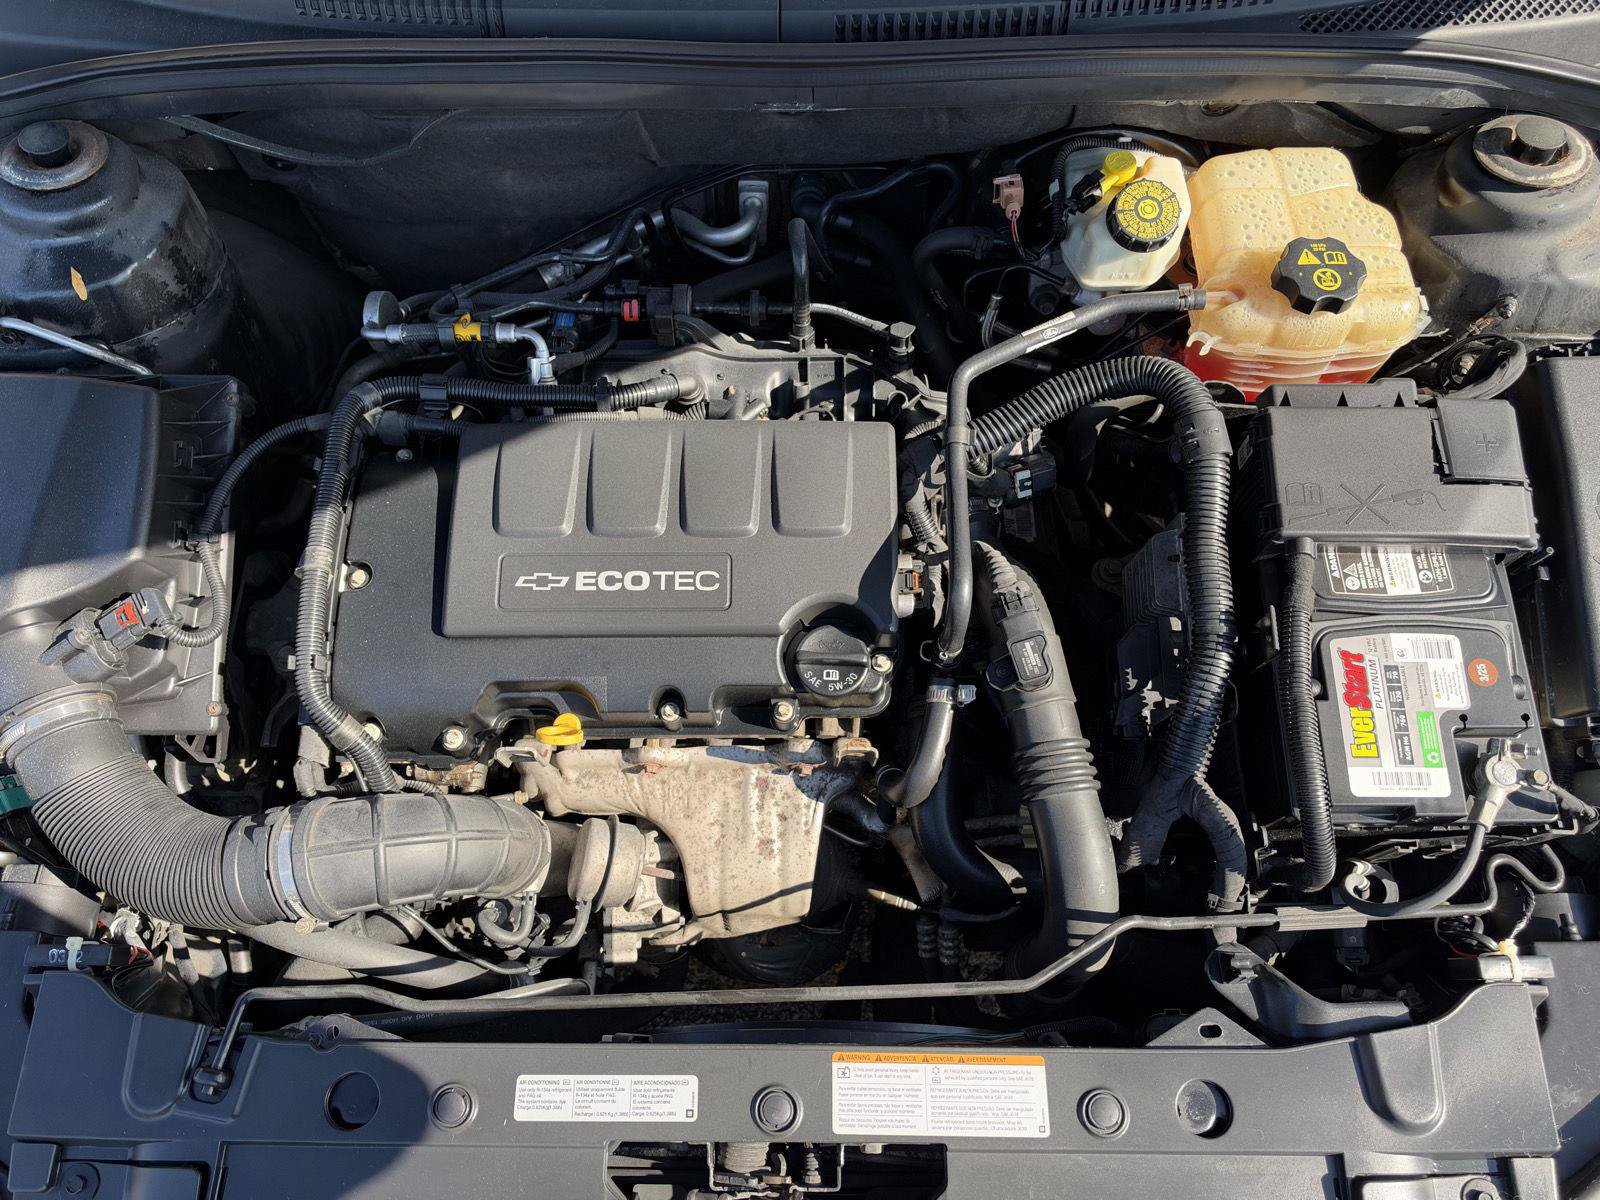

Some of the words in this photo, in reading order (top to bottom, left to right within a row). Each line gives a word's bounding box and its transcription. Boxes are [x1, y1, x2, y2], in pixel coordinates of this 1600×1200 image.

[576, 571, 720, 591] ECOTEC
[804, 671, 822, 688] SAE
[828, 672, 858, 692] 5W-30
[1476, 664, 1489, 682] 3/25
[1368, 658, 1384, 710] PLATINUM
[1338, 649, 1380, 758] EverStart
[48, 948, 83, 964] 032
